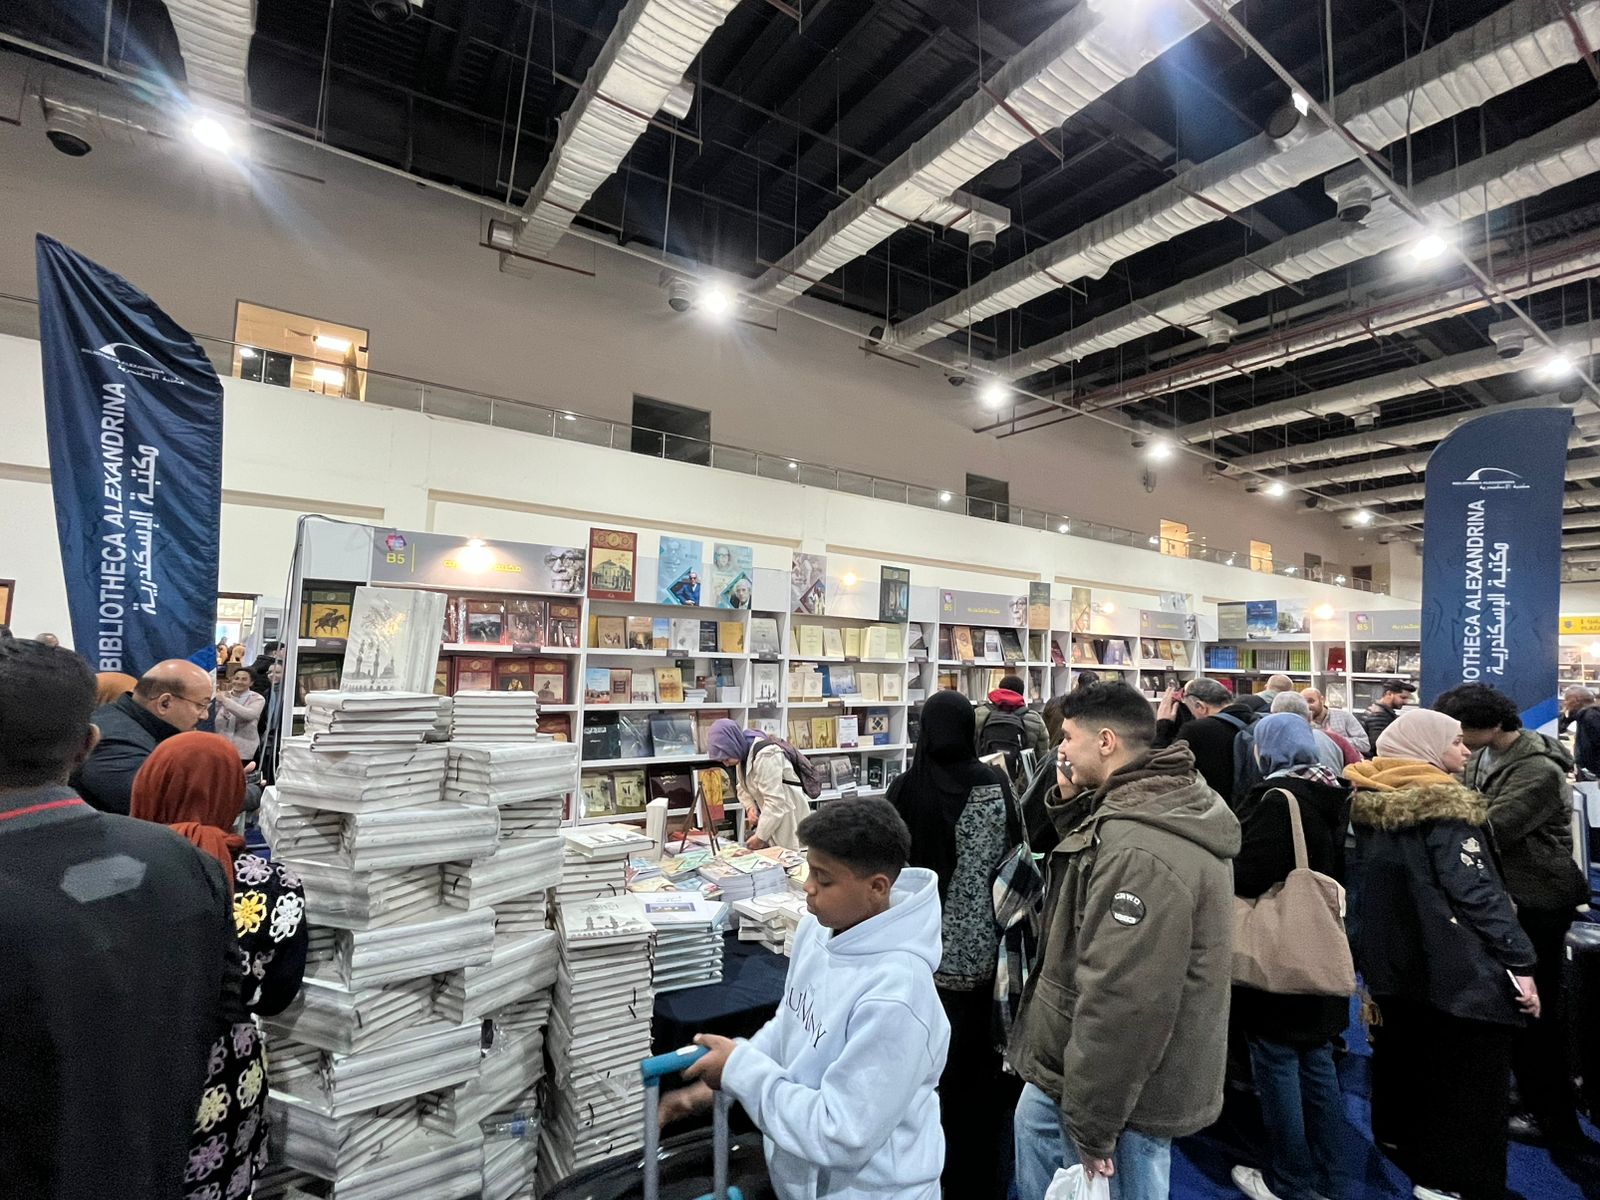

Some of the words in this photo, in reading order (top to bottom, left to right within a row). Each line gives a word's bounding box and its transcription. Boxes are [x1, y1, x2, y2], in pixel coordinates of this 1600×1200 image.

[100, 383, 126, 529] ALEXANDRINA
[129, 444, 161, 505] مكتبة
[129, 511, 160, 615] الإسكندرية
[386, 552, 405, 565] B5
[1465, 500, 1486, 611] ALEXANDRINA
[1486, 542, 1511, 589] مكتبة
[98, 533, 126, 672] BIBLIOTHECA
[1486, 593, 1511, 676] الإسكندرية
[1462, 614, 1481, 684] IOTHECA
